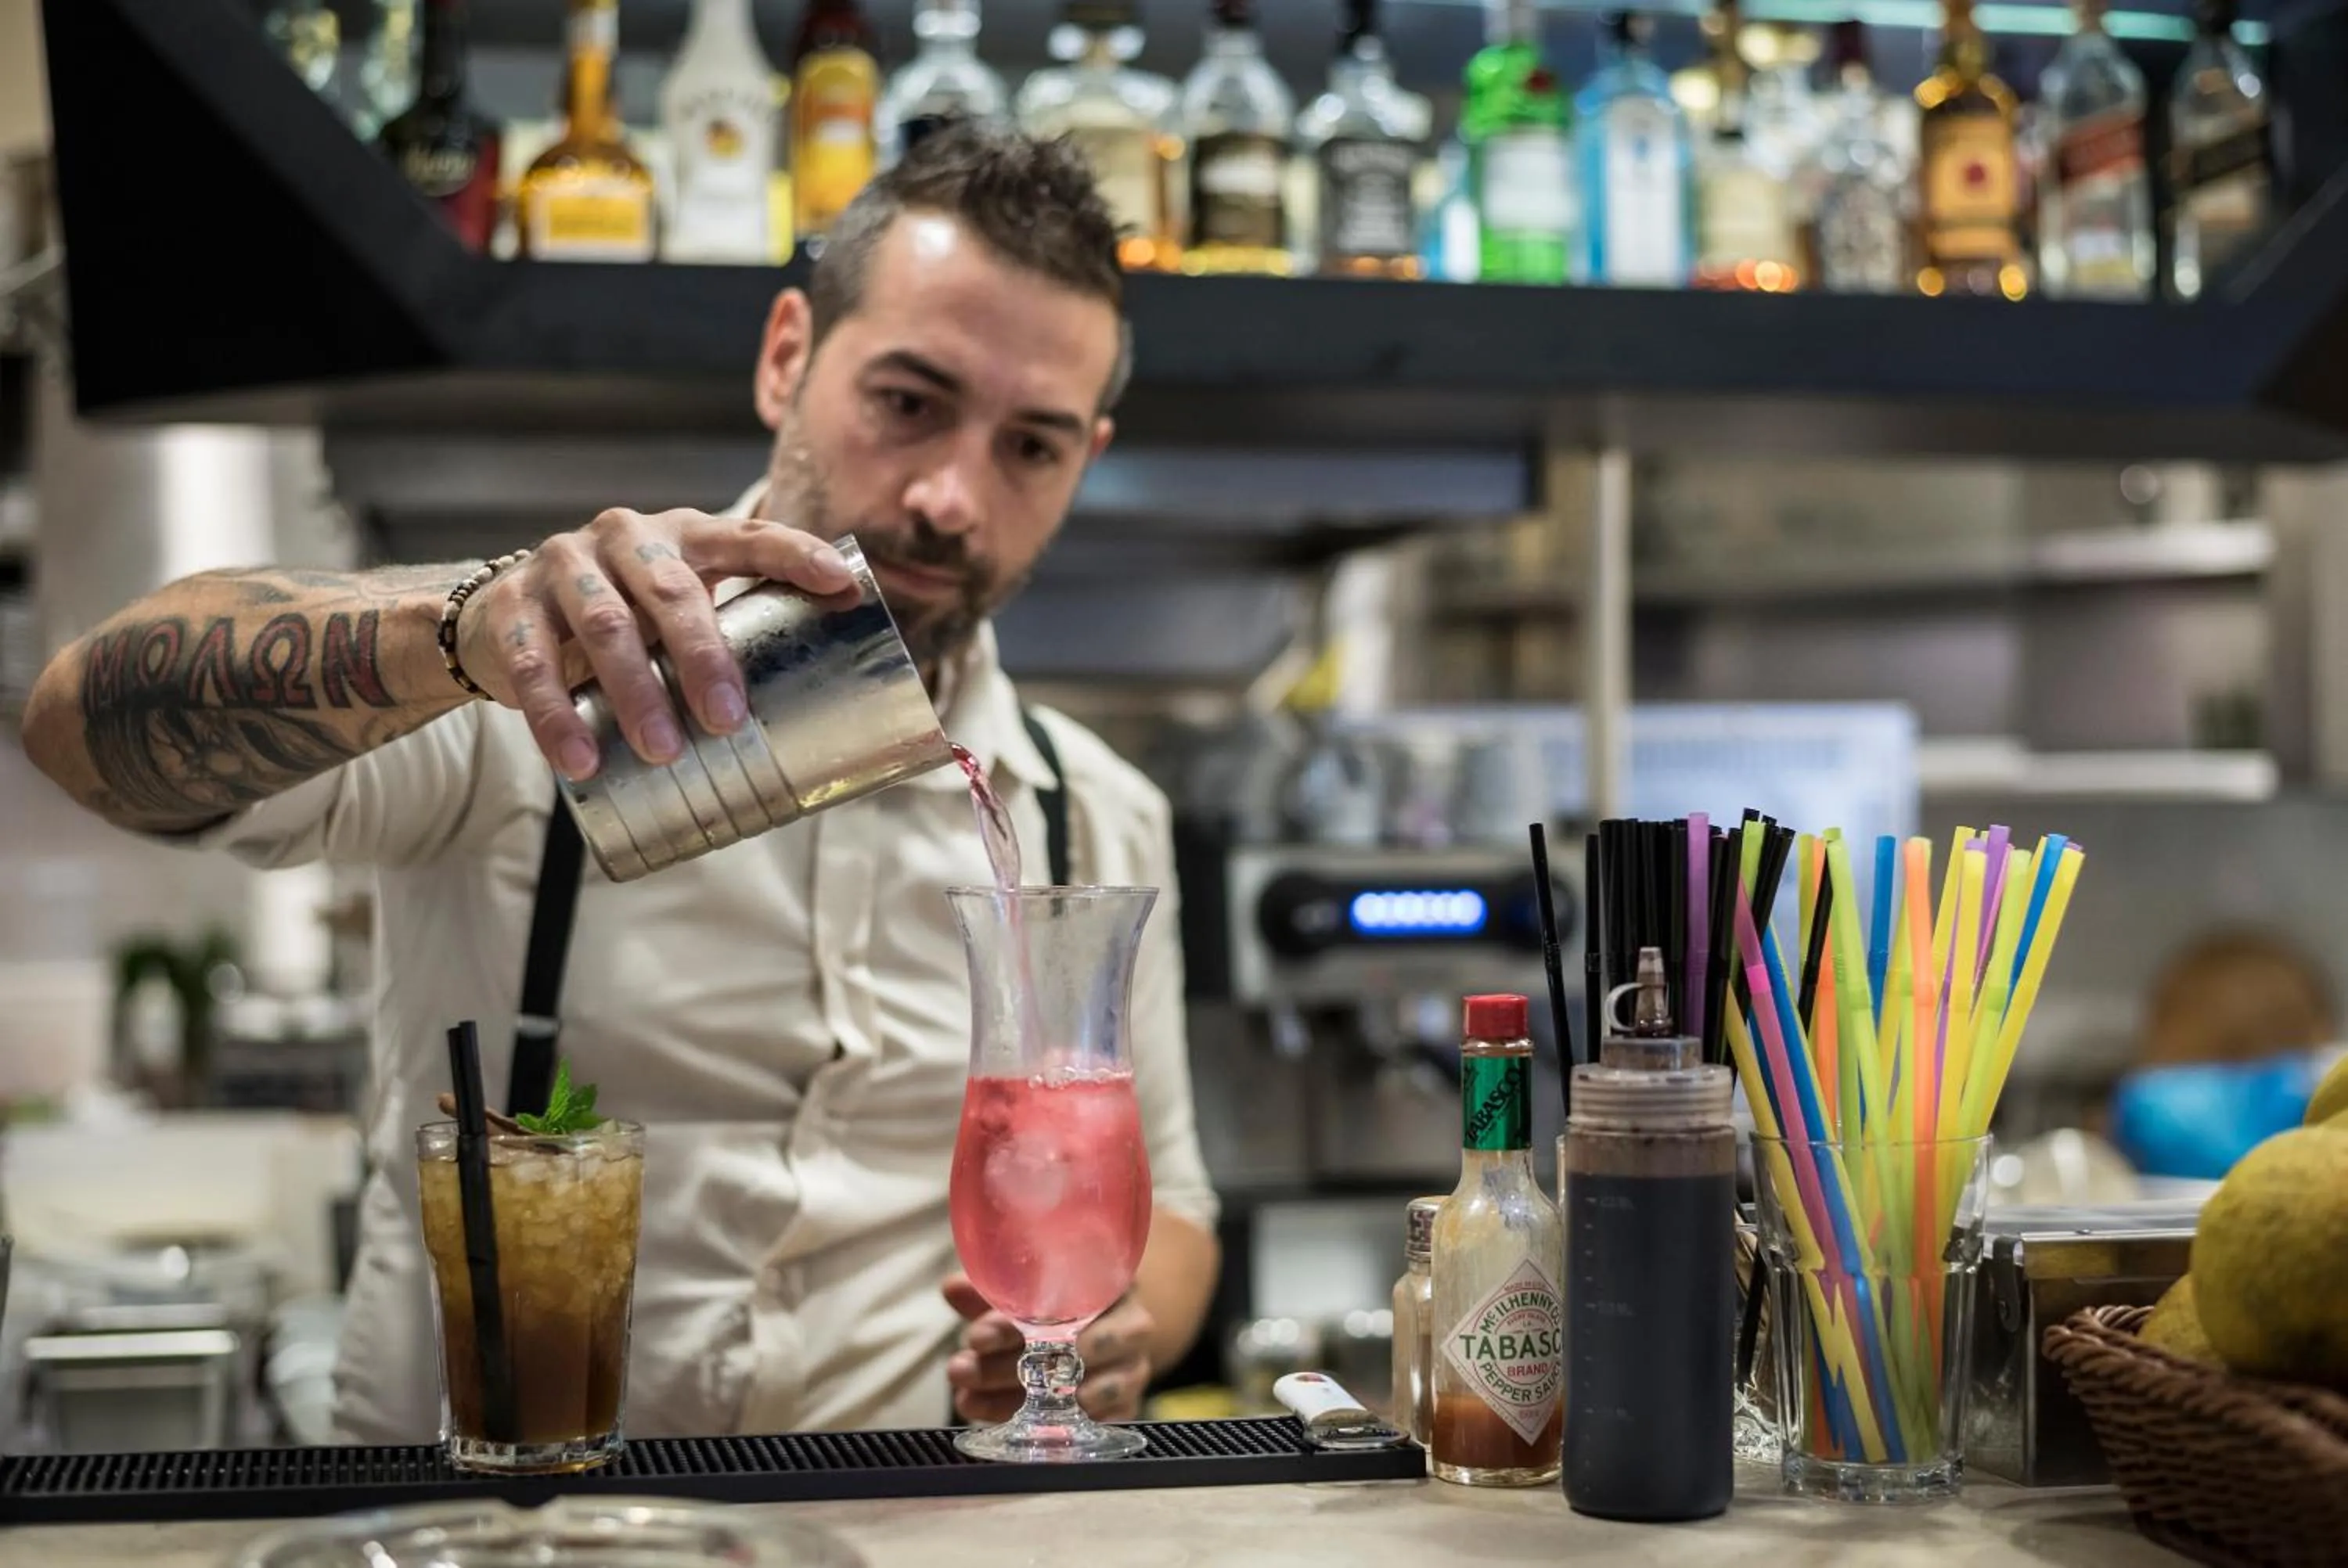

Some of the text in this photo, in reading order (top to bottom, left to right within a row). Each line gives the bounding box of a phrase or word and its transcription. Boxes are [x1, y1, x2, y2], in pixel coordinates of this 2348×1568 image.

[1459, 1329, 1561, 1360] TABASC
[1480, 1361, 1532, 1402] PEPPER
[1507, 1362, 1549, 1376] BRAND
